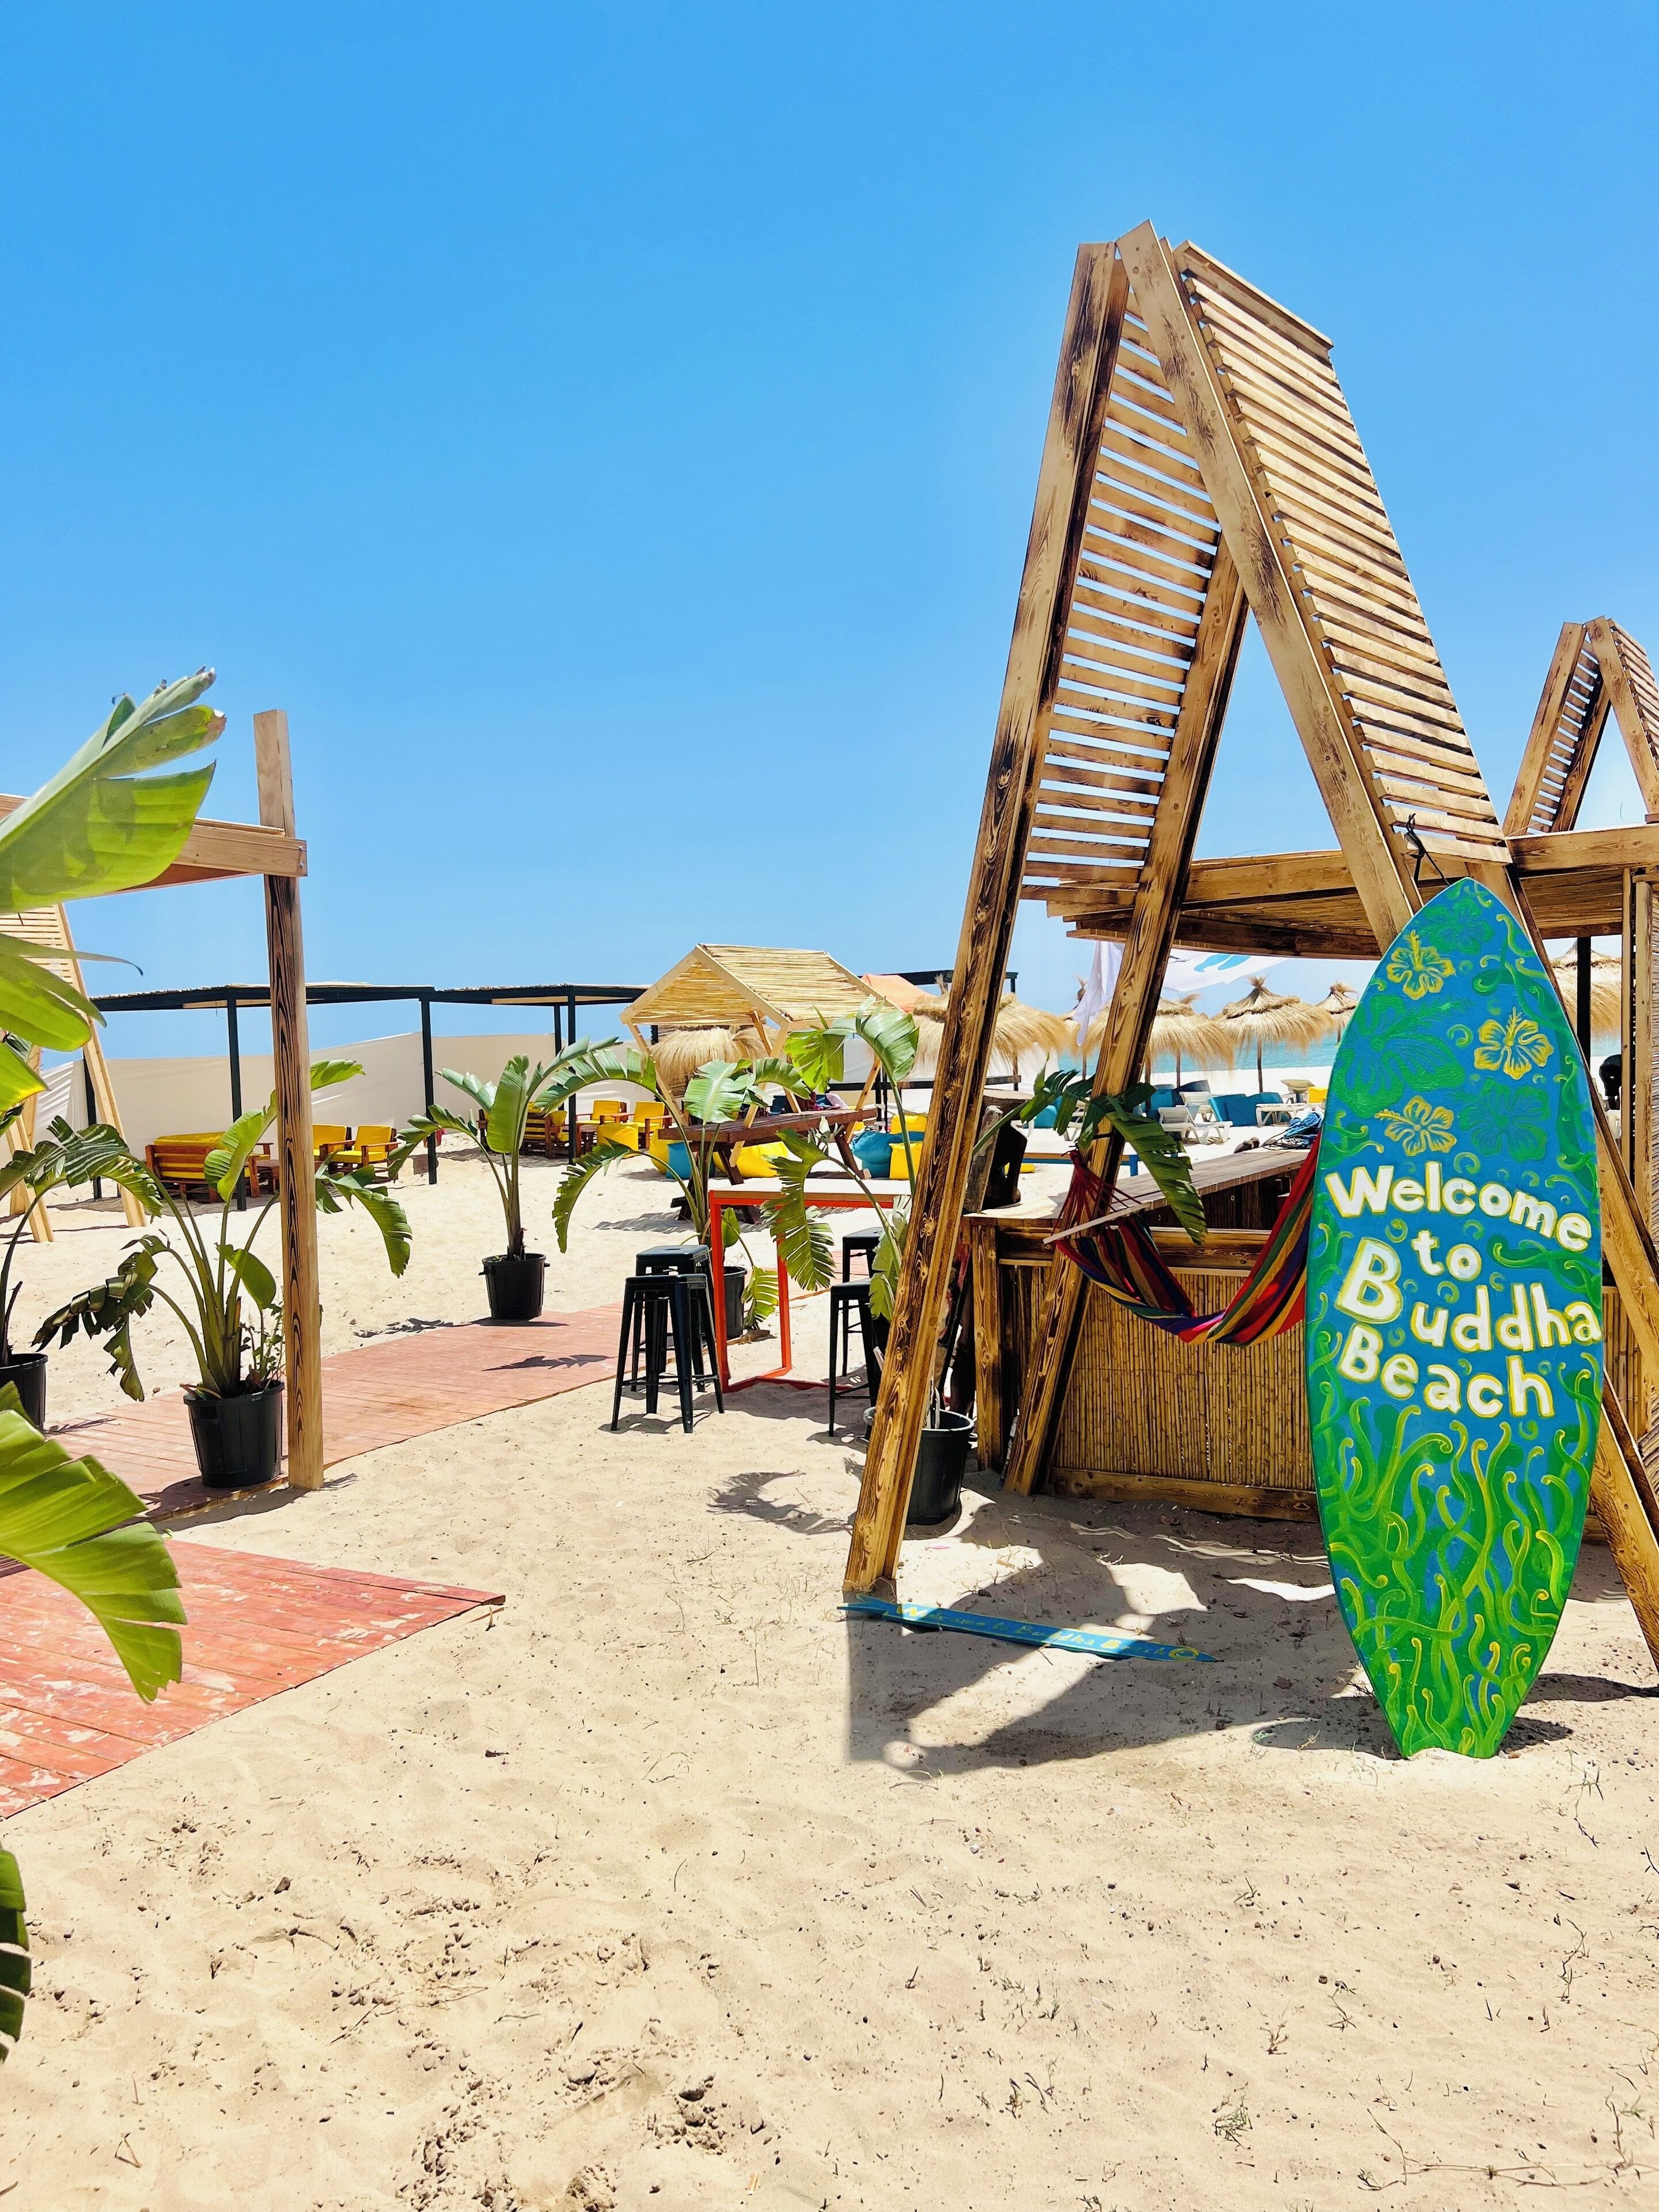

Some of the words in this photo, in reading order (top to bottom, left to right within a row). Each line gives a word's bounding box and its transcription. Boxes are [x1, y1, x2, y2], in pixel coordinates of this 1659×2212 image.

[1325, 1161, 1592, 1252] Welcome
[1334, 1237, 1602, 1352] Buddha
[1411, 1230, 1482, 1281] to
[1338, 1323, 1555, 1418] Beach
